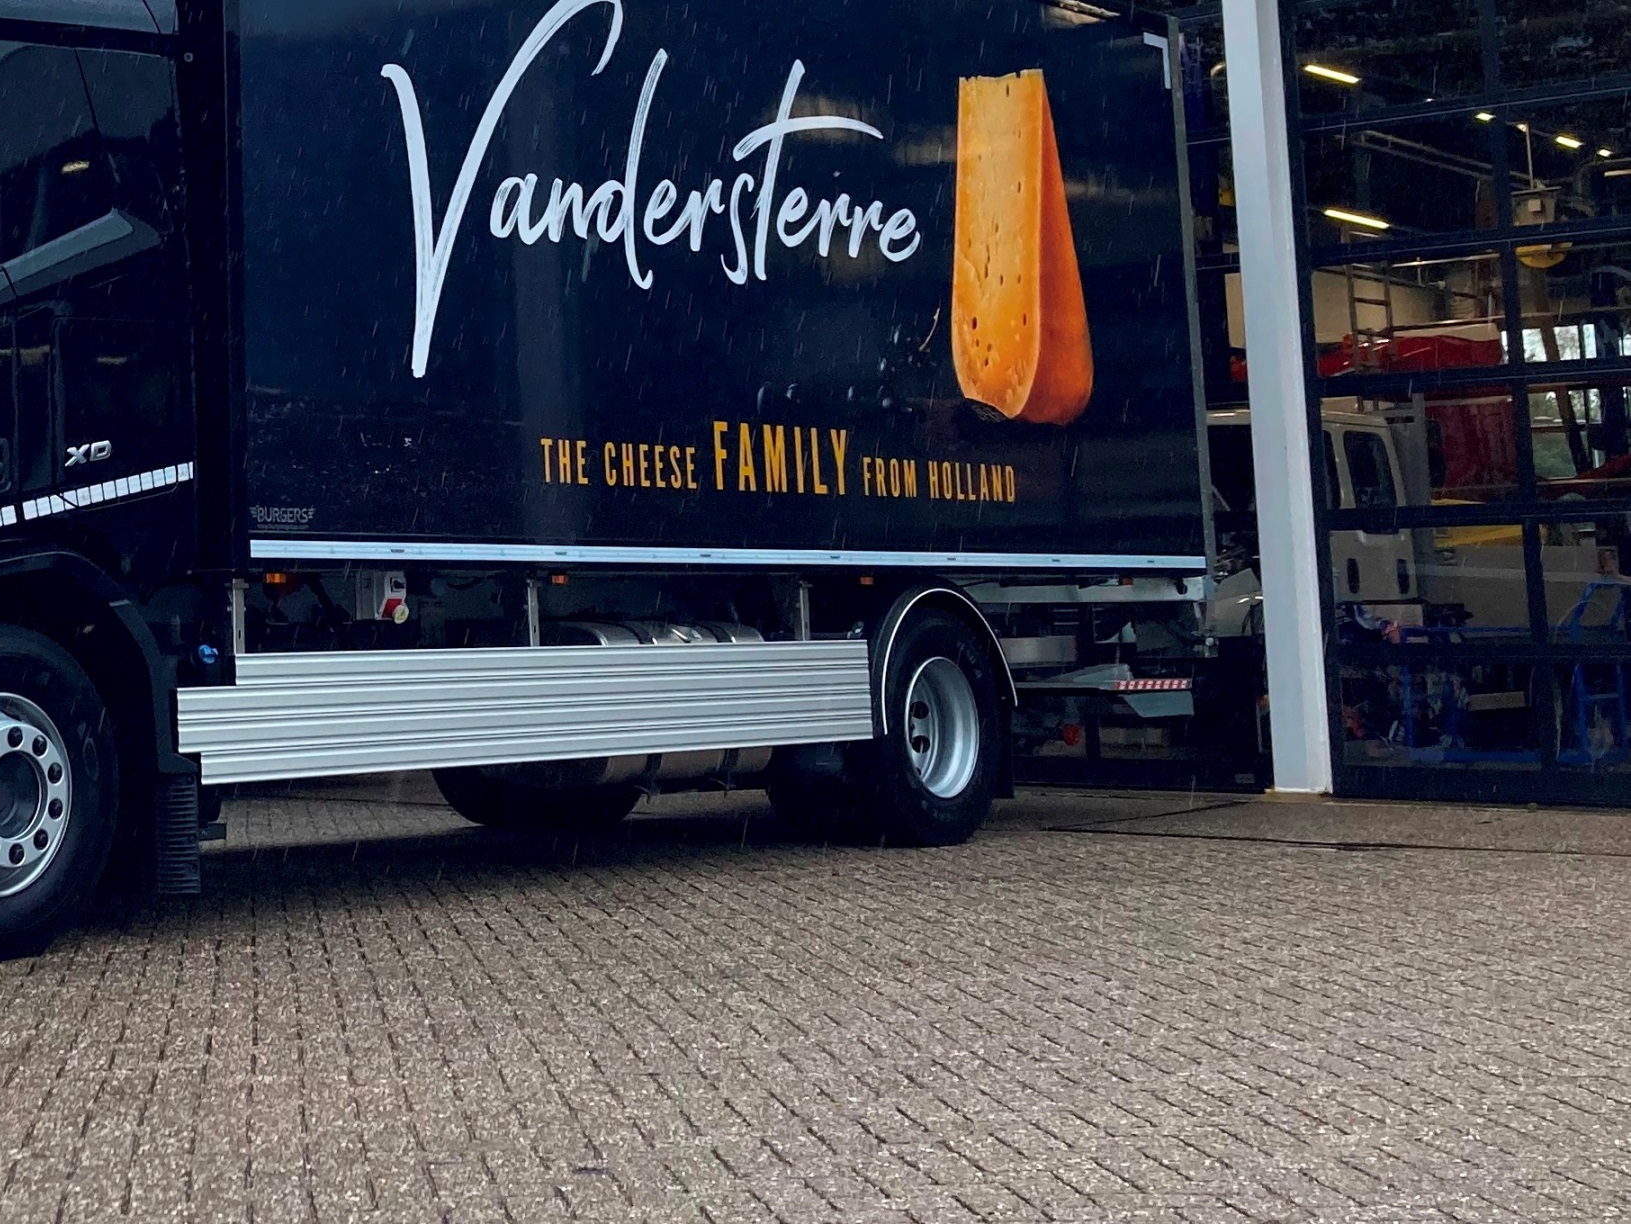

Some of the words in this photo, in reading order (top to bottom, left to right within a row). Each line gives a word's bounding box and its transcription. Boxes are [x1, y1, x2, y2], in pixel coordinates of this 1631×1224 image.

[64, 440, 112, 467] XD
[540, 437, 590, 486] THE
[603, 441, 698, 490] CHEESE
[713, 420, 848, 496] FAMILY
[862, 456, 918, 498] FROM
[928, 460, 1016, 503] HOLLAND
[257, 507, 309, 524] BURGERS
